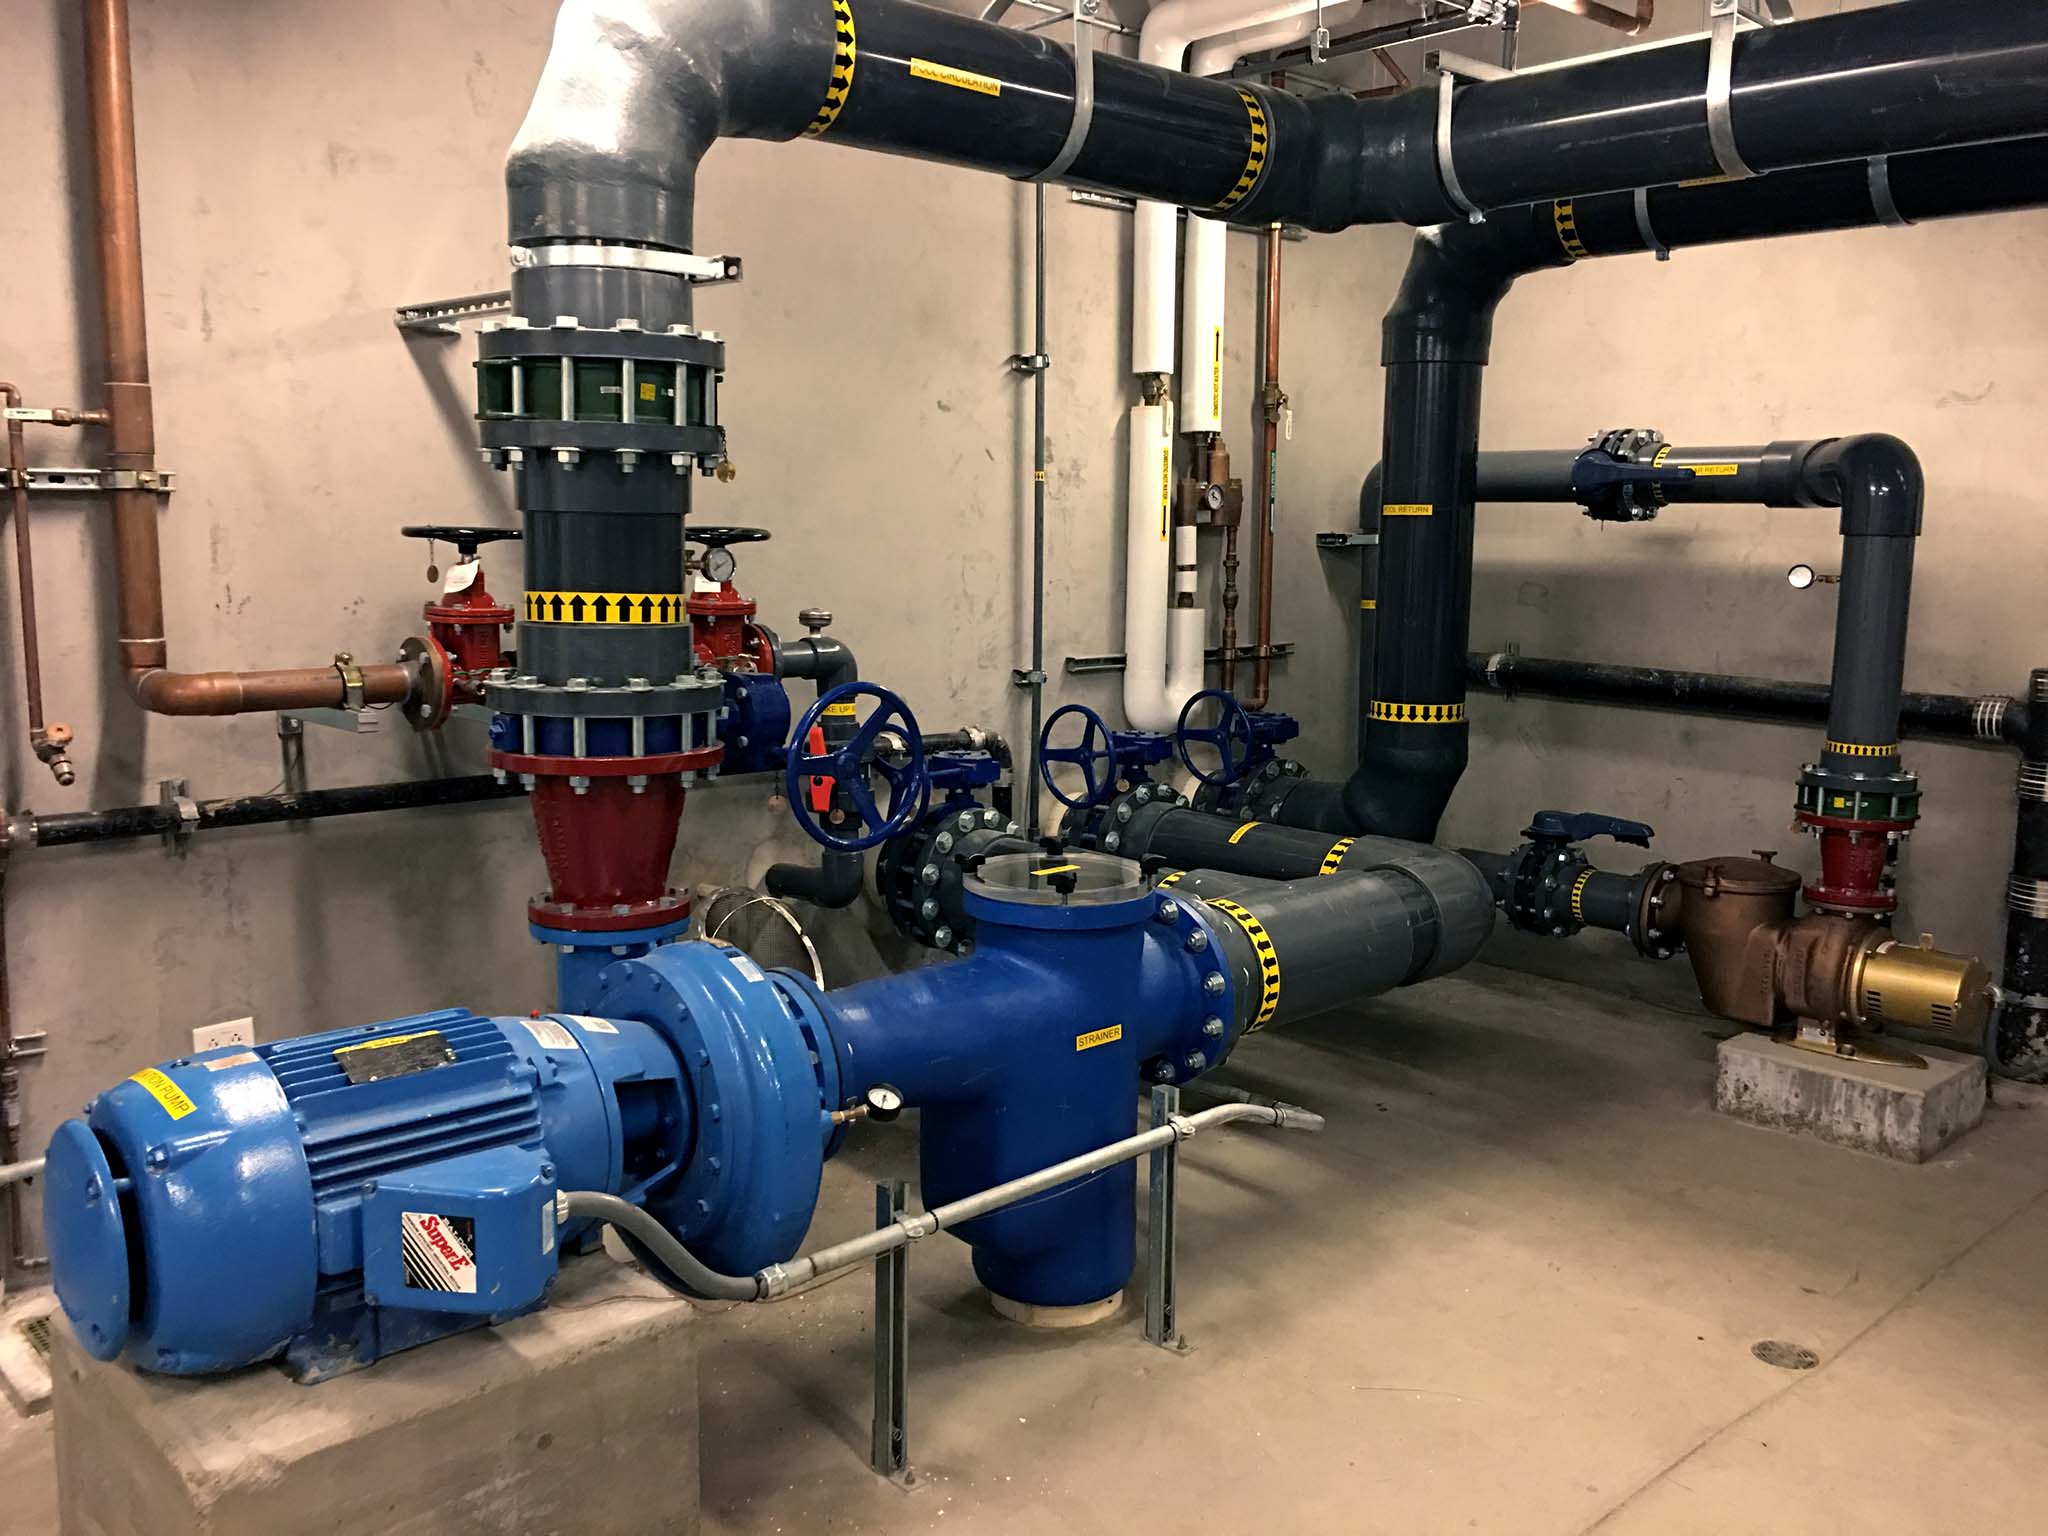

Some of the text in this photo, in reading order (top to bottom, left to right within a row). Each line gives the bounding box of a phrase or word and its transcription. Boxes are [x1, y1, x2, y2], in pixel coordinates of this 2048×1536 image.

[839, 705, 850, 713] UP
[1078, 1027, 1121, 1047] STRAINER
[160, 1085, 190, 1111] PUMP
[441, 1217, 474, 1258] BALDOR
